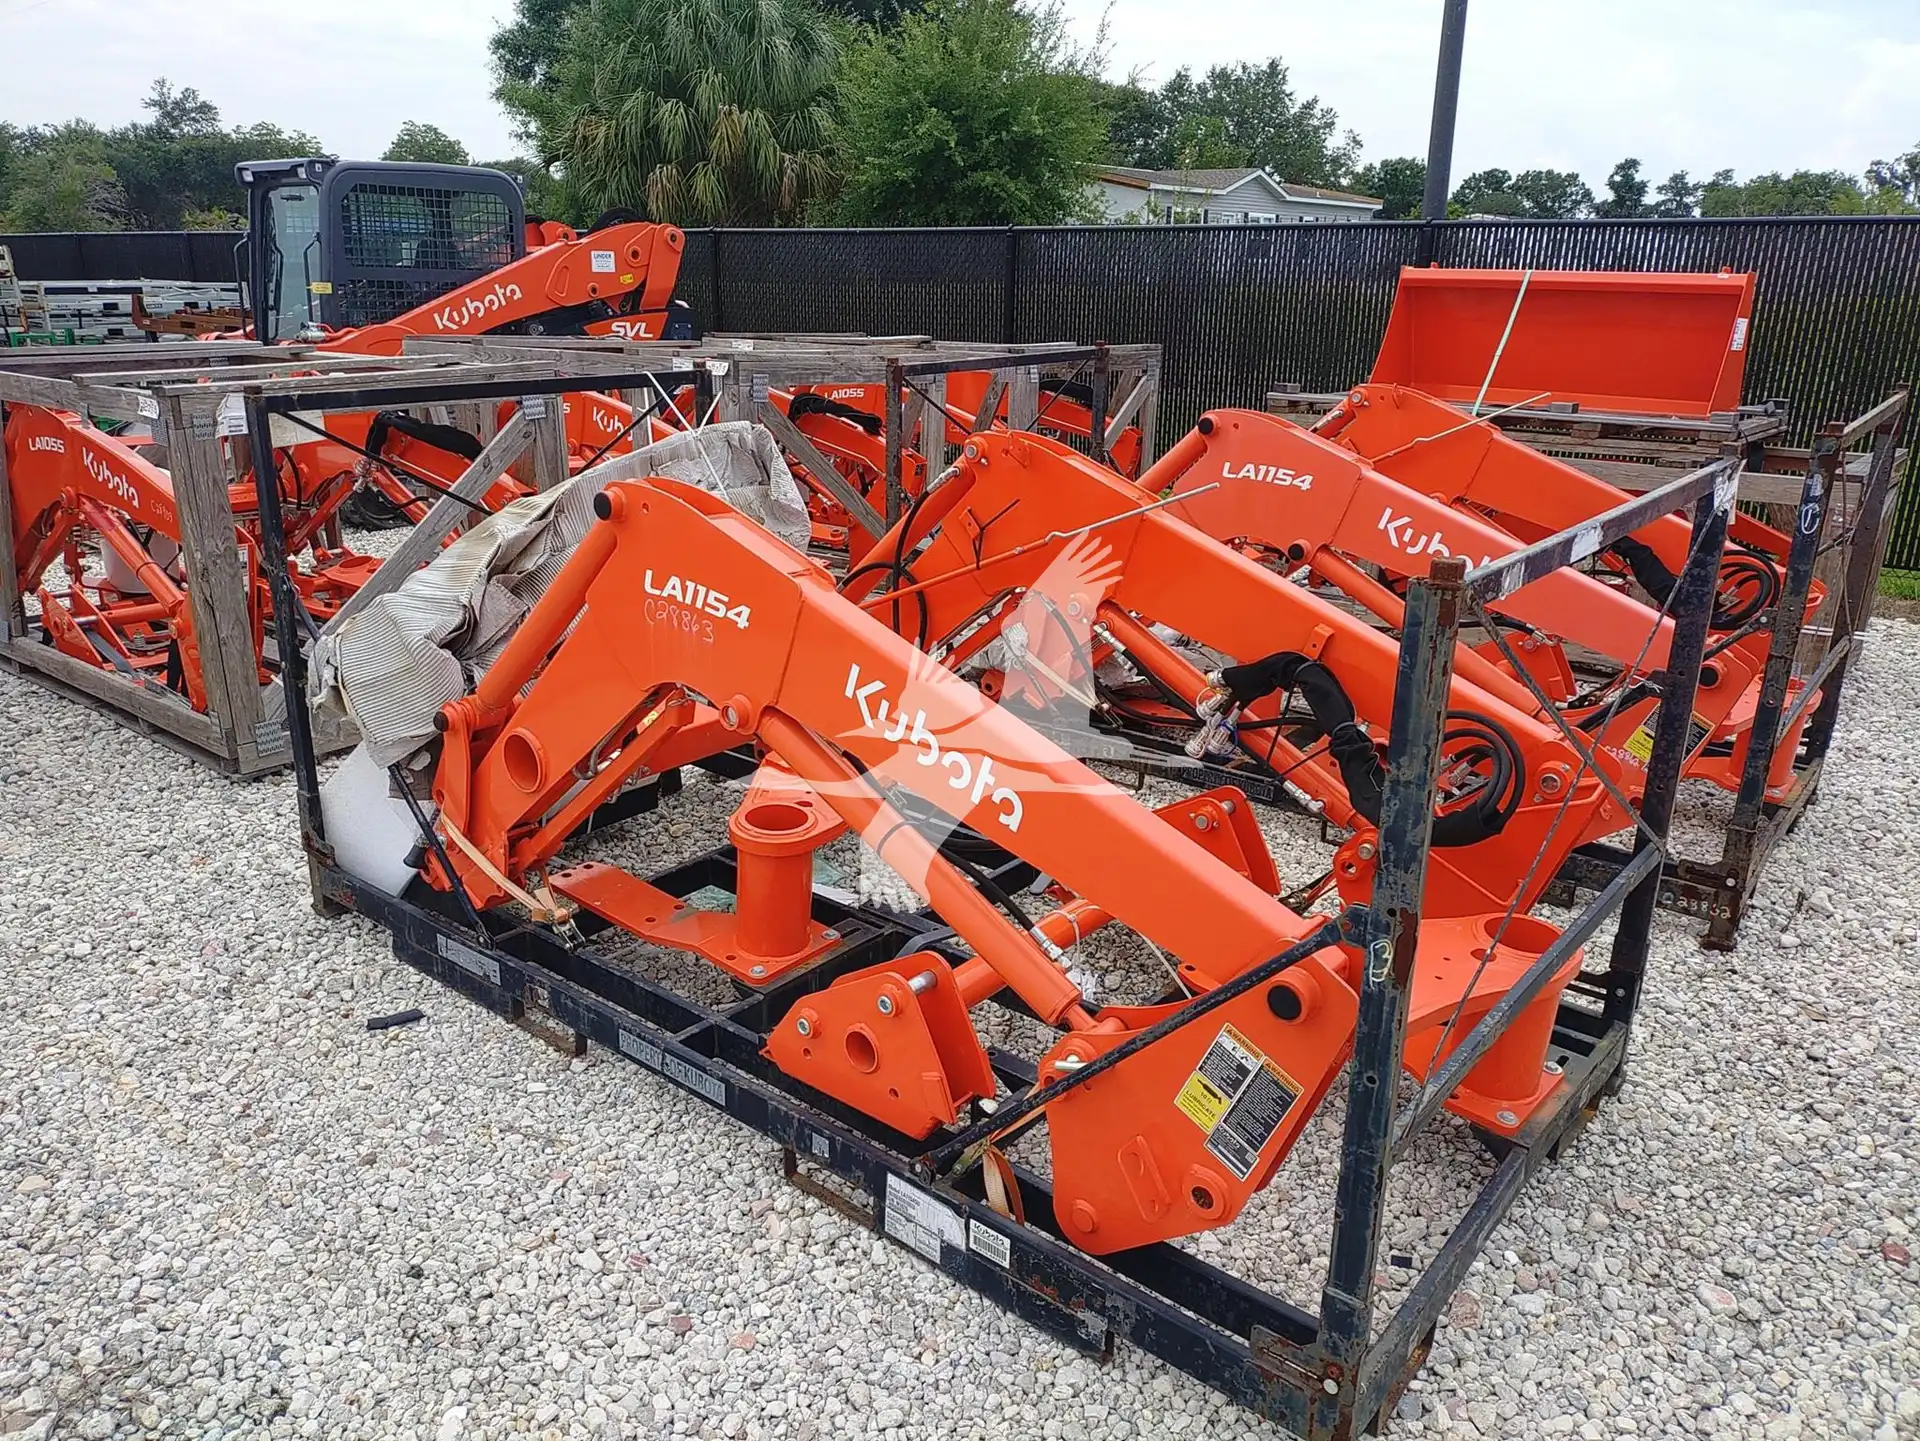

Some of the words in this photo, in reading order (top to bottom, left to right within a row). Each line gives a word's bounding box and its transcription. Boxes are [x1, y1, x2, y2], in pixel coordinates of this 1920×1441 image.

[433, 284, 523, 330] Kubota
[611, 321, 654, 338] SVL
[28, 437, 65, 454] LA1055
[82, 446, 140, 509] Kubota
[1221, 461, 1314, 491] LA1154
[644, 569, 751, 629] LA1154
[844, 662, 1023, 833] Kubota
[1231, 1031, 1260, 1059] WARNING
[683, 1063, 725, 1099] KUBOTA
[1271, 1064, 1300, 1094] WARNING
[1185, 1090, 1216, 1119] LUBRICATE
[973, 1222, 1005, 1246] Kubota
